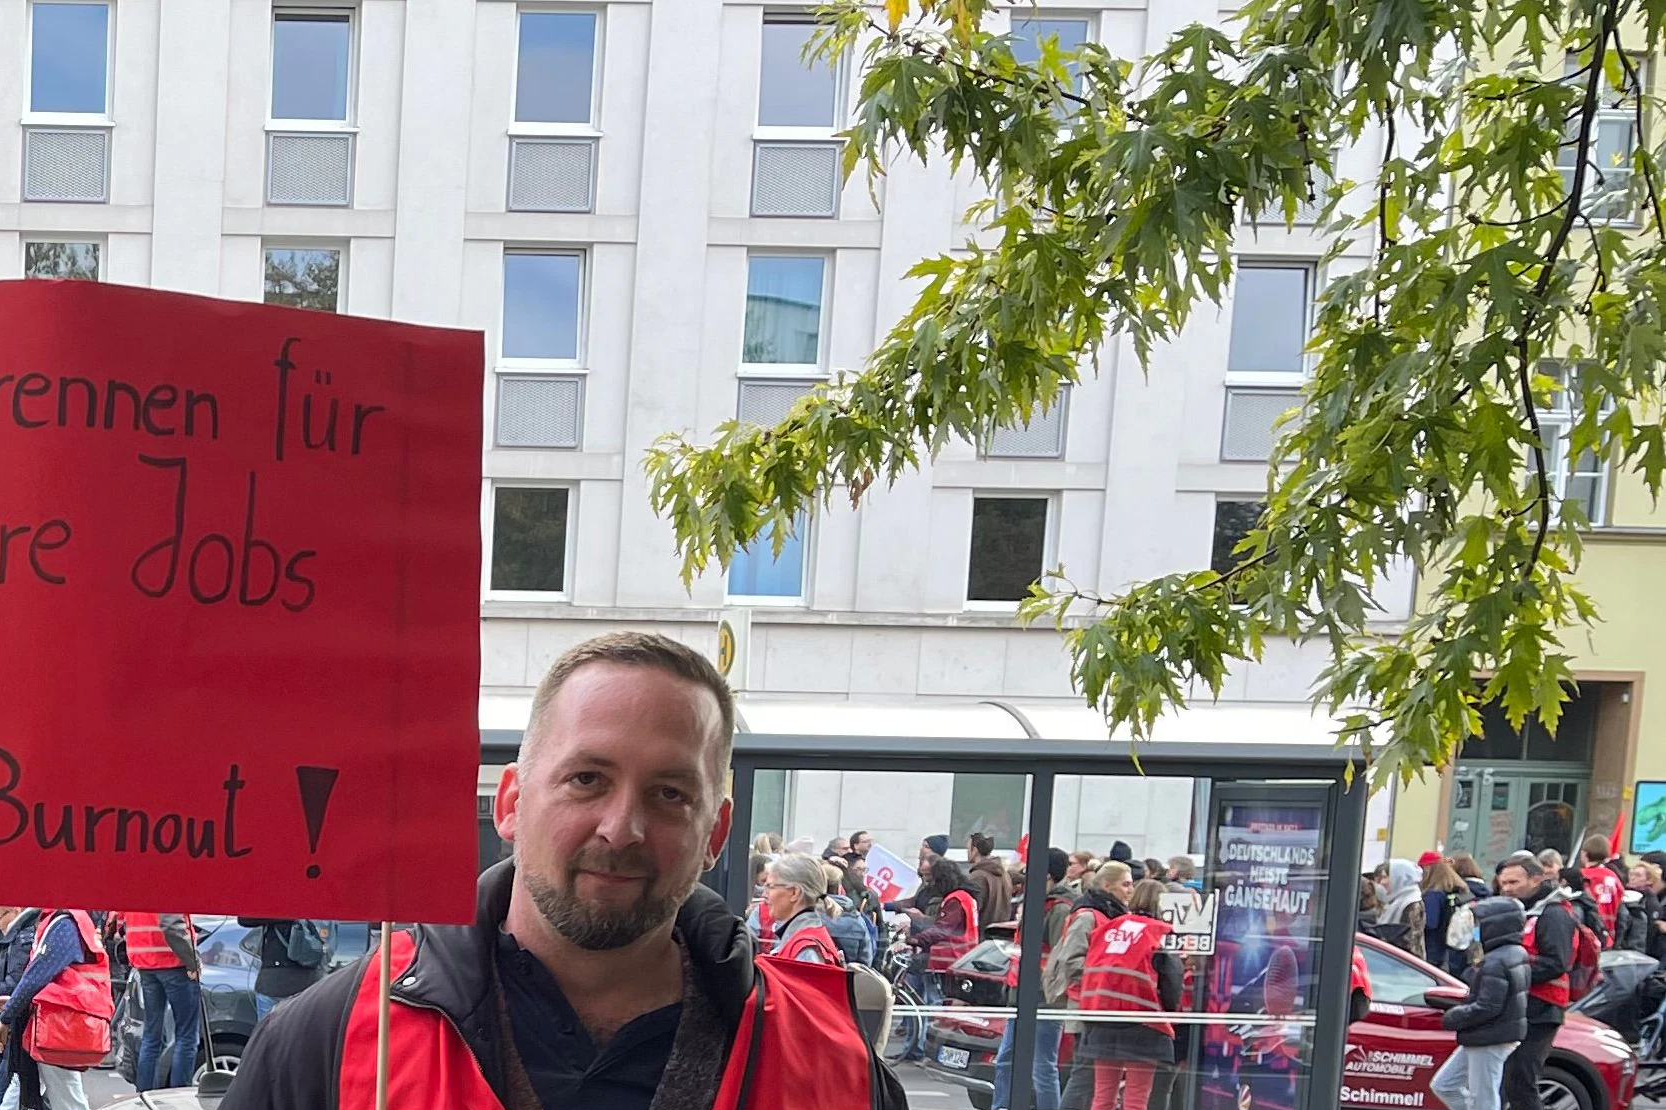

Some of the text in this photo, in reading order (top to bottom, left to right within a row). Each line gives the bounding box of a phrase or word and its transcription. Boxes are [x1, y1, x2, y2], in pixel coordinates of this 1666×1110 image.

[274, 337, 385, 462] für
[130, 455, 317, 613] Jobs
[1228, 843, 1315, 866] DEUTSCHLANDS
[1225, 879, 1310, 914] GÄNSEHAUT
[1105, 928, 1143, 945] GEW
[1345, 1061, 1415, 1075] AUTOMOBILE
[1373, 1051, 1434, 1066] SCHIMMEL
[1340, 1086, 1424, 1107] Schimmel!
